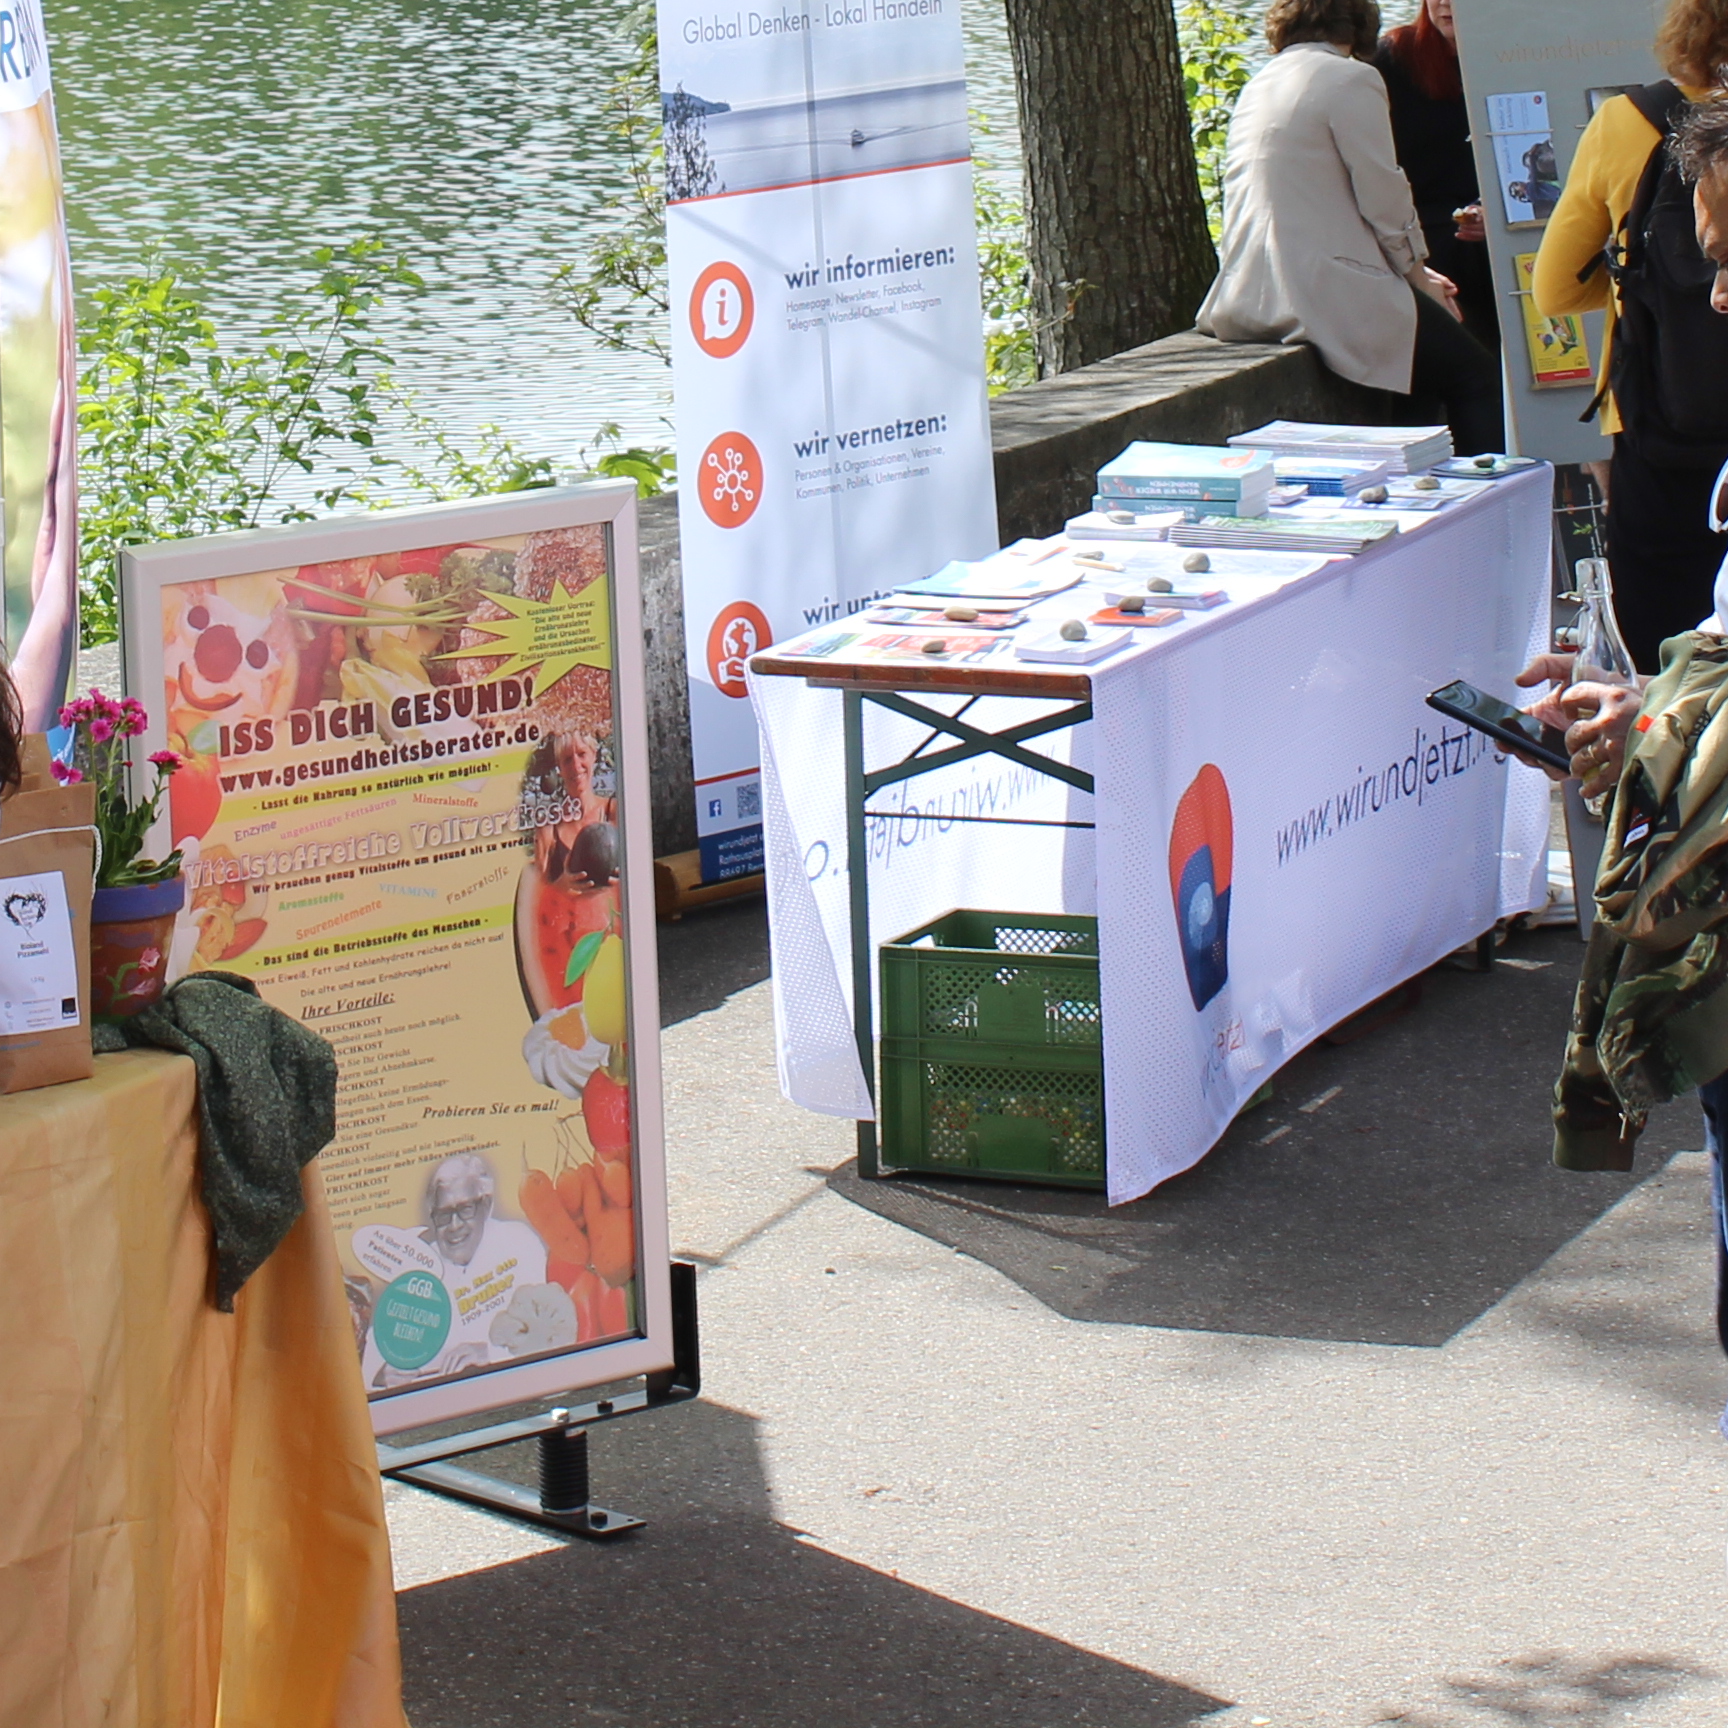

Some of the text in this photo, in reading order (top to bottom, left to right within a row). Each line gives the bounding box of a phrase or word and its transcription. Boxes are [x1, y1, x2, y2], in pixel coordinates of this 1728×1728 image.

[683, 12, 742, 44] Global
[748, 7, 810, 37] Denken
[784, 247, 955, 289] wir informieren:
[786, 279, 925, 313] Homepage, Newsletter, Facebook,
[787, 296, 942, 332] Telegram, Wandel-Channel, Instagram
[793, 414, 947, 458] wir vernetzen:
[795, 445, 945, 481] Personen & Organisationen, Vereine,
[796, 465, 930, 499] Kommunen, Politik, Unternehmen
[803, 596, 840, 625] wir
[219, 676, 534, 759] ISS DICH GESUND!
[220, 723, 540, 793] www.gesundheitsberater.de
[261, 762, 492, 810] Lasst die Nahrung so natürlich wie möglich!
[412, 793, 480, 809] Mineralstoffe
[234, 819, 277, 842] Enzyme
[279, 796, 398, 841] ungesättigte Fettsäuren
[185, 797, 583, 889] Vitalstoffreiche Vollwertkost:
[252, 882, 270, 894] Wir
[274, 874, 322, 890] brauchen
[325, 868, 355, 883] genug
[359, 858, 410, 875] Vitalstoffe
[414, 856, 429, 865] um
[433, 848, 466, 864] gesund
[469, 845, 483, 856] alt
[486, 844, 497, 852] zu
[446, 865, 510, 905] Faserstoffe
[278, 891, 344, 912] Aromastoffe
[379, 883, 438, 899] VITAMINE
[296, 899, 382, 940] Spurenelemente
[17, 948, 49, 958] Pizzamehl
[263, 917, 481, 966] Das sind die Betriebsstoffe des Menschen
[278, 932, 504, 983] Eiweiß, Fett und Kohlenhydrate reichen da nicht aus!
[300, 961, 452, 998] Die alte und neue Ernährungslehre!
[300, 991, 396, 1021] Ihre Vorteile:
[319, 1016, 383, 1035] FRISCHKOST
[422, 1098, 559, 1118] Probieren Sie es mal!
[326, 1175, 389, 1195] FRISCHKOST
[403, 1244, 434, 1269] 50.000
[407, 1277, 433, 1299] GGB
[456, 1274, 514, 1316] Bruker
[461, 1296, 505, 1326] 1909-2001
